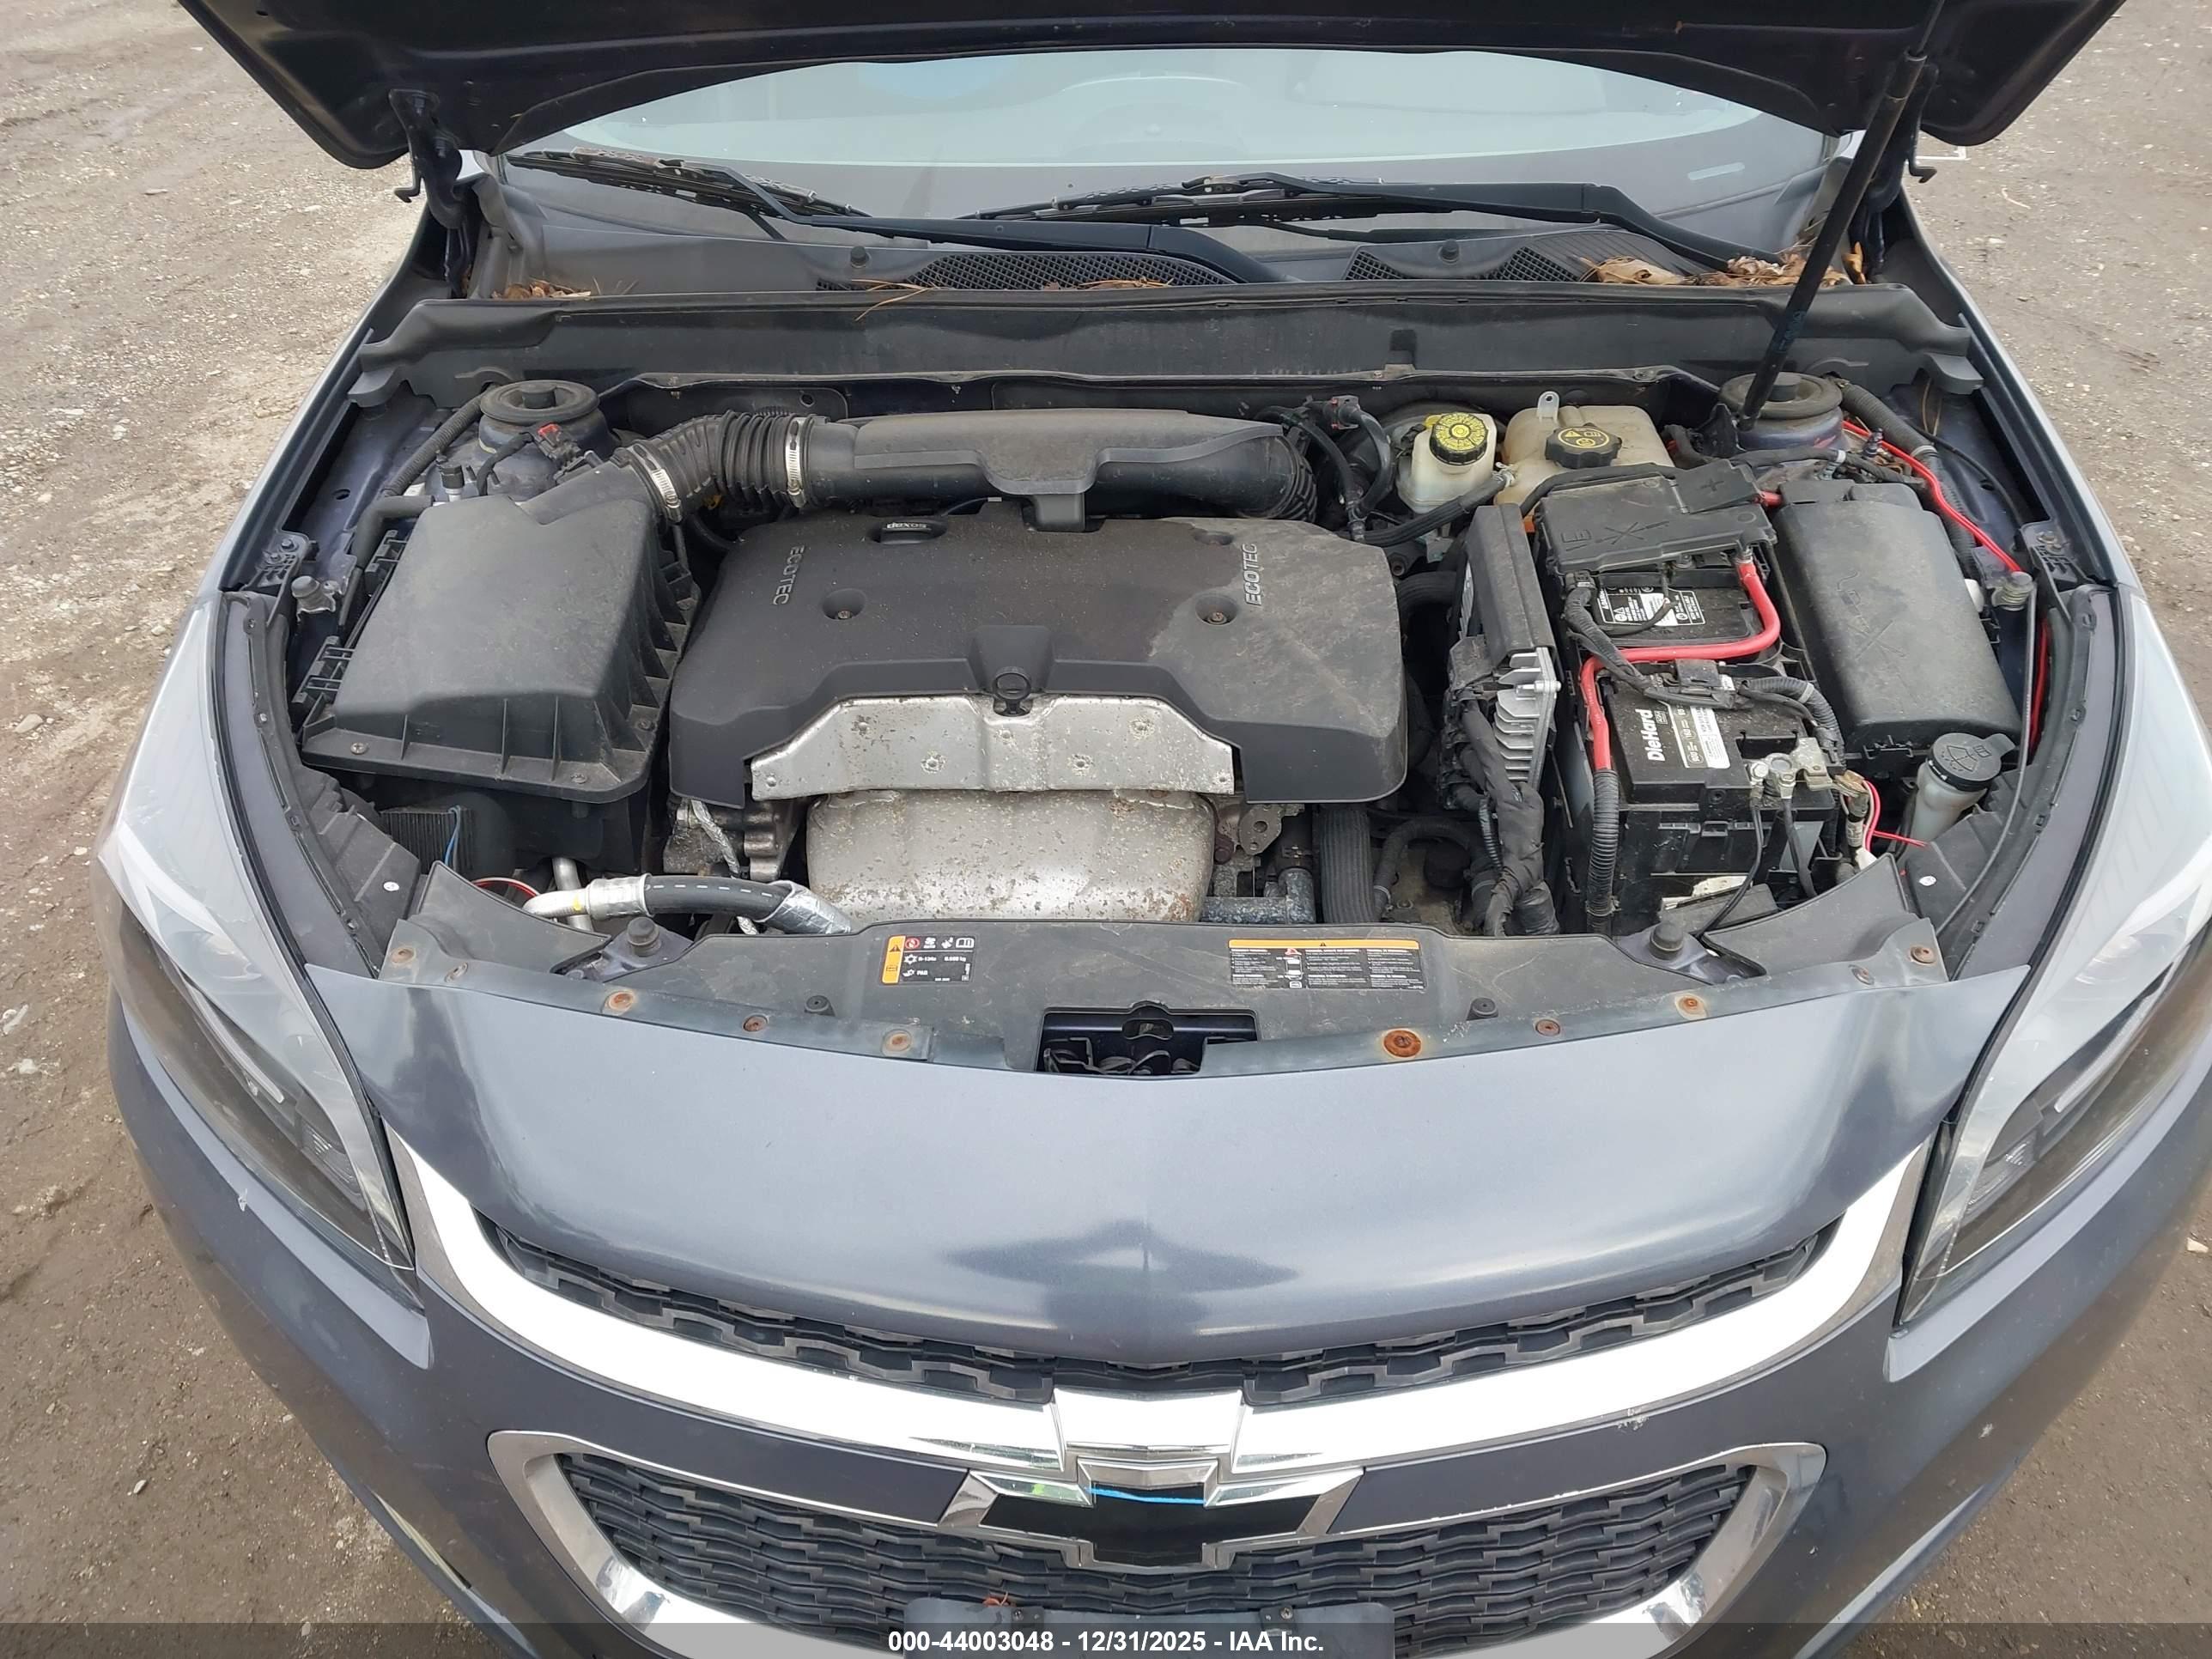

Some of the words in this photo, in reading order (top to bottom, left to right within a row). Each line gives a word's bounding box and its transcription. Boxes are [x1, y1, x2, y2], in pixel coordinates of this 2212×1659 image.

[773, 544, 805, 605] ECOTEC
[1242, 543, 1262, 606] ECOTEC
[1634, 708, 1666, 762] DieHard
